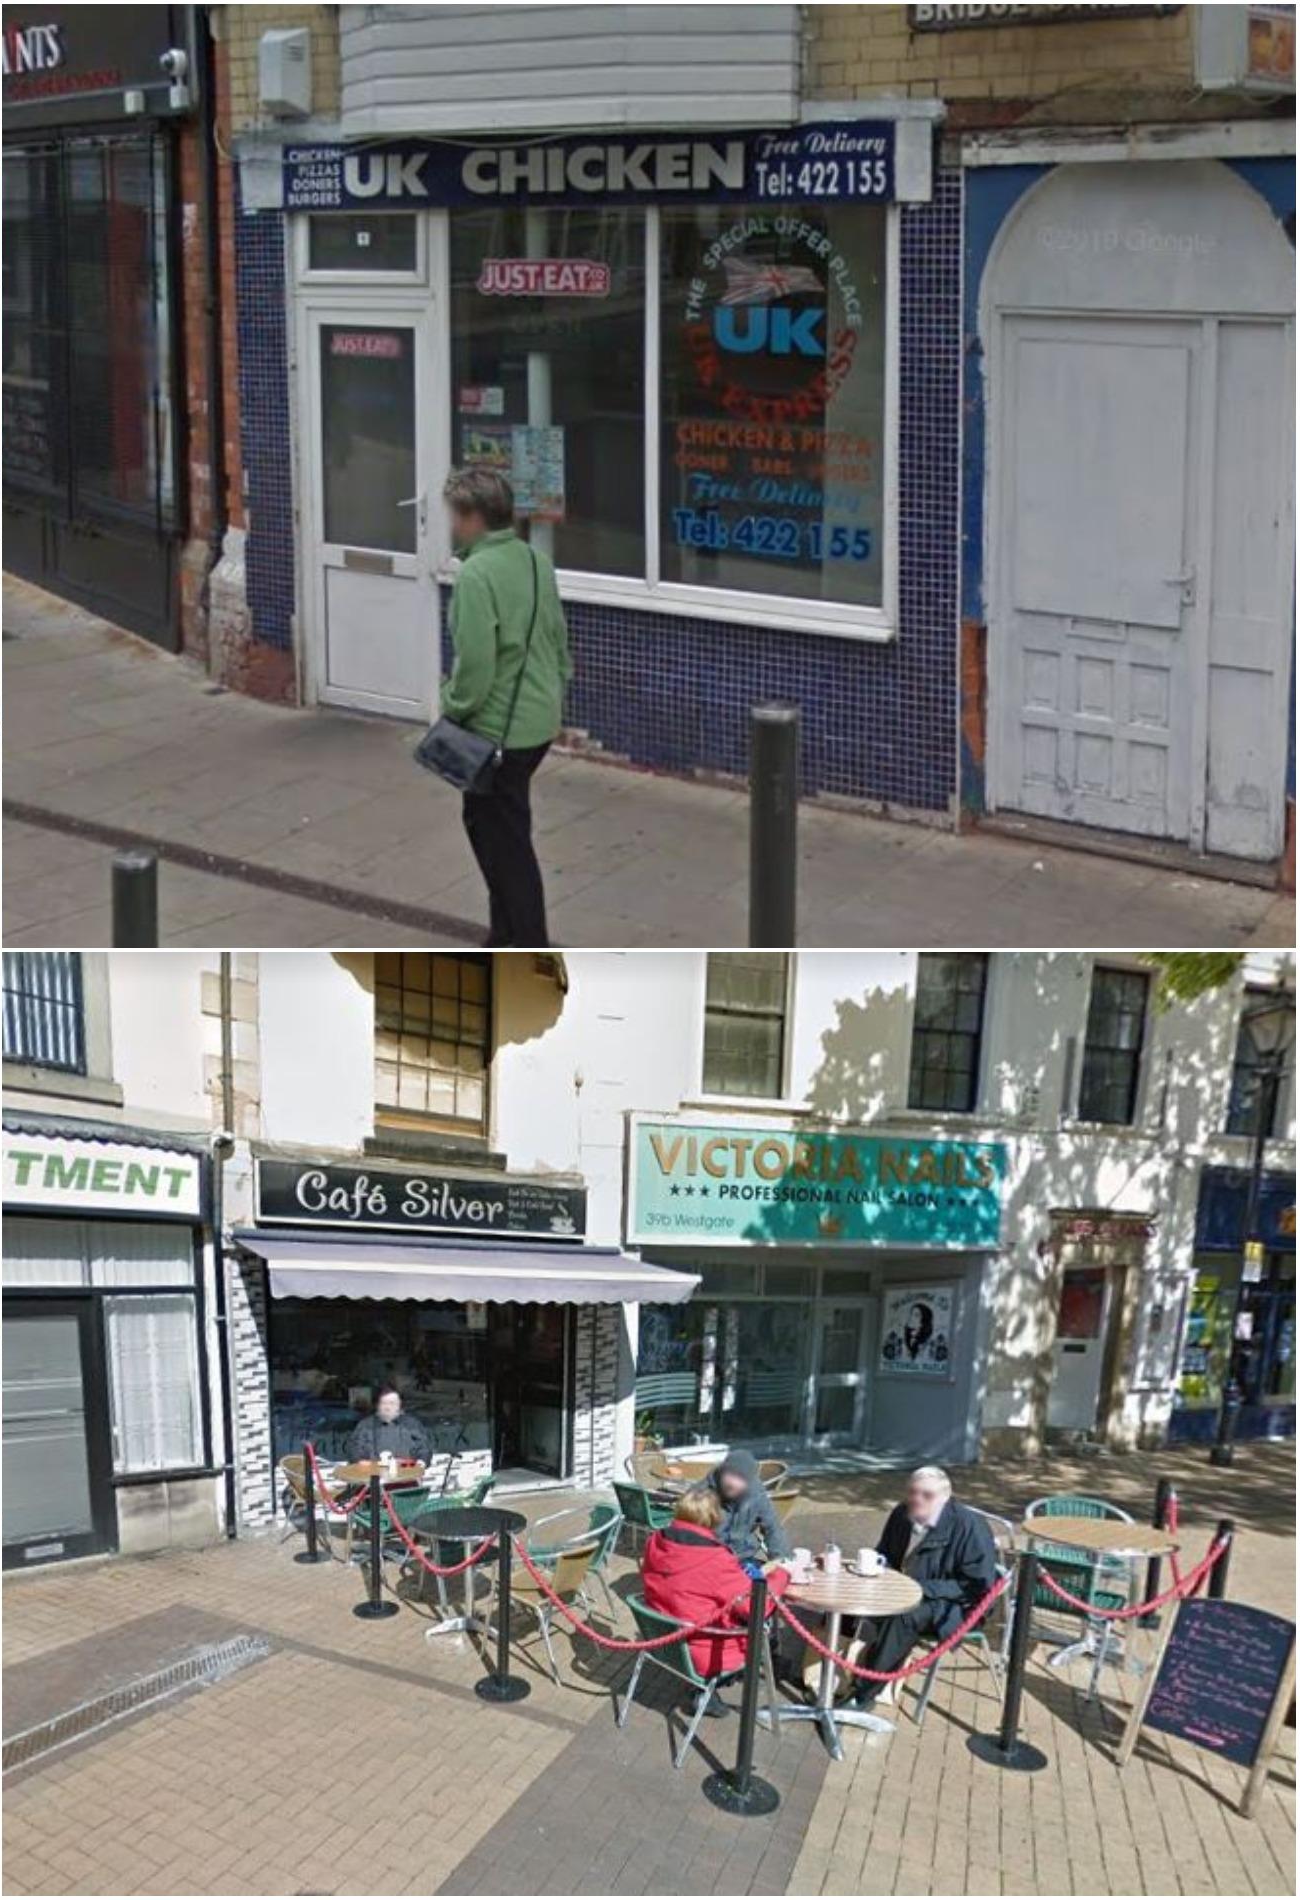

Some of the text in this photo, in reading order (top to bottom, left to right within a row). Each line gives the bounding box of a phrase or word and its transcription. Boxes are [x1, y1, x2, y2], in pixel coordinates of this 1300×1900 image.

[288, 150, 341, 163] CHICKEN
[758, 132, 886, 159] Free Delivery
[298, 164, 341, 177] PIZZAS
[344, 142, 745, 197] UK CHICKEN
[756, 161, 887, 197] Tel: 422 155
[289, 192, 342, 205] BURGERS
[293, 178, 341, 191] DONERS
[482, 264, 590, 290] JUST EAT
[685, 216, 863, 326] THE SPECIAL OFFER PLACE
[714, 306, 826, 355] UK
[678, 421, 776, 449] CHICKEN
[689, 471, 741, 501] Free
[675, 509, 871, 561] Tel: 422 155
[650, 1134, 993, 1188] VICTORIA NAILS
[296, 1170, 503, 1223] Café Silver
[719, 1185, 939, 1207] PROFESSIONAL NAIL SALON
[645, 1212, 734, 1229] 39b Westgate
